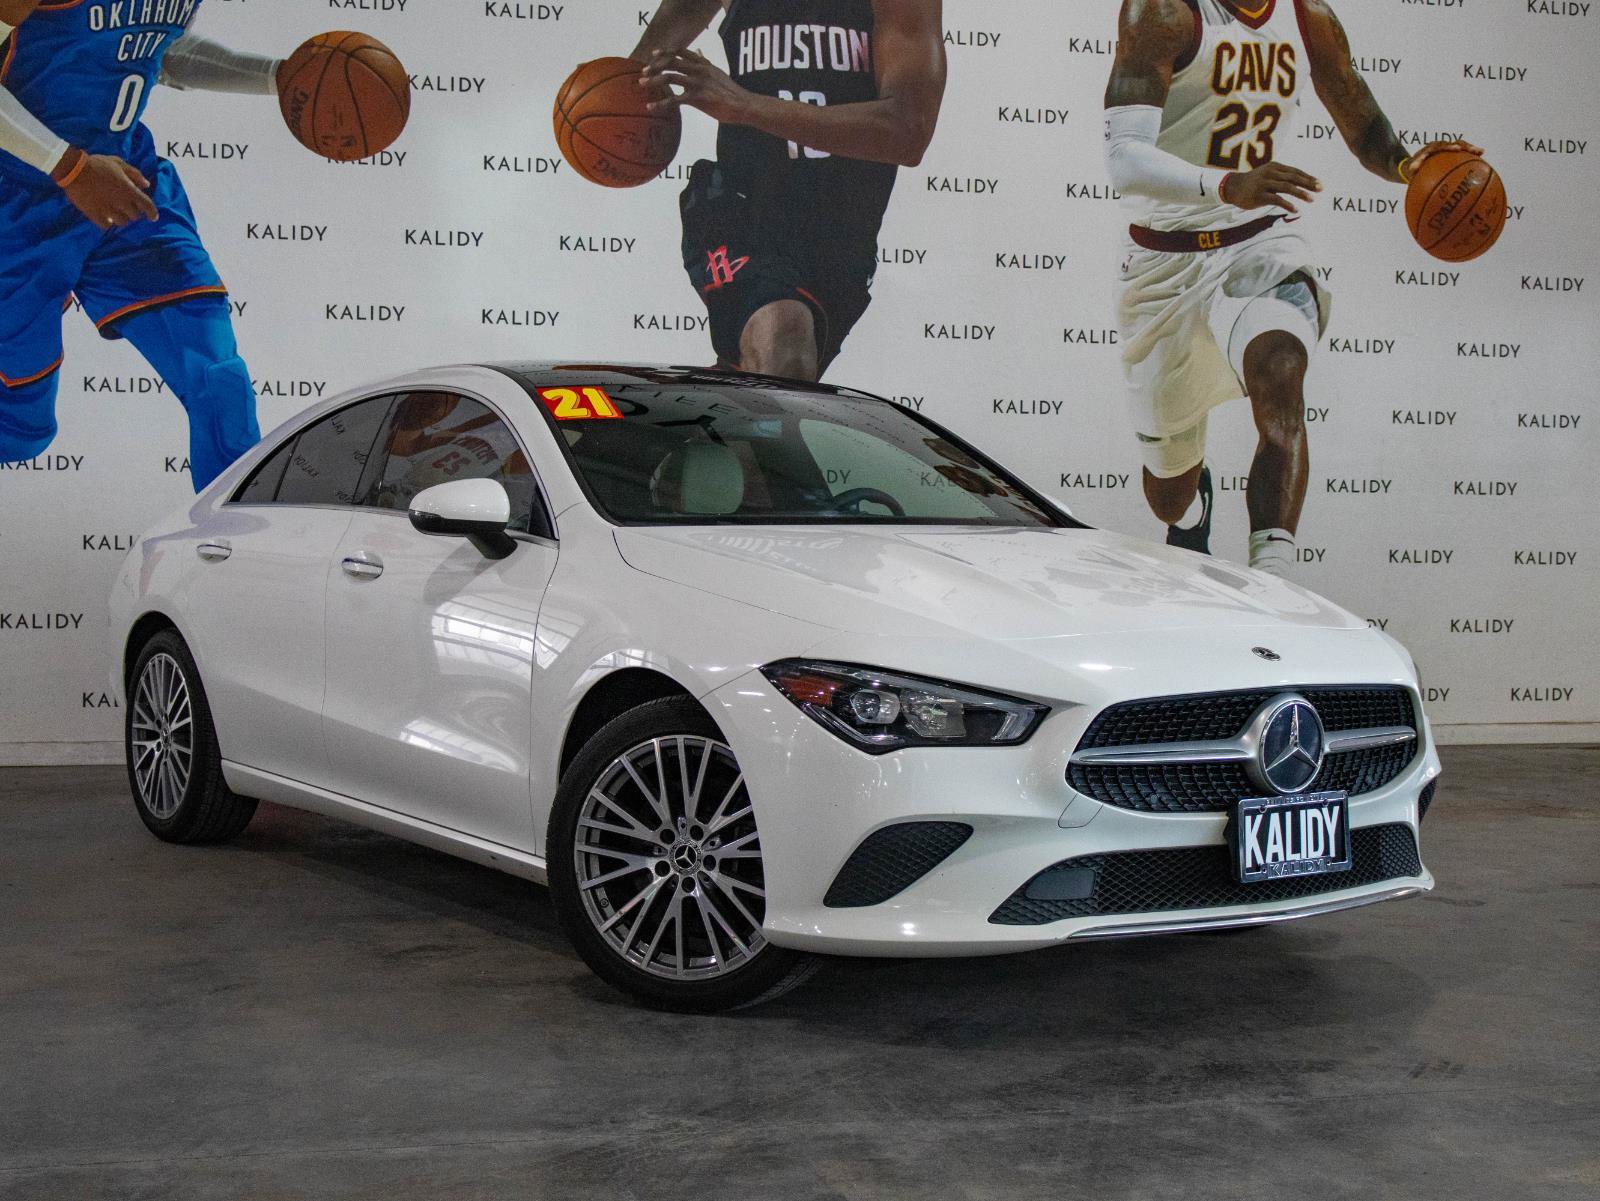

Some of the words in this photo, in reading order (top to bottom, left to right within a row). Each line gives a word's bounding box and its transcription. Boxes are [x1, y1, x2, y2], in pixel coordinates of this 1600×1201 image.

[89, 0, 196, 31] OKLAHOM
[486, 1, 564, 21] KALIDY
[1528, 0, 1591, 16] KALIDY
[117, 32, 167, 61] CITY
[944, 30, 1000, 47] ALIDY
[1069, 38, 1119, 54] KALI
[738, 24, 870, 75] HOUSTON
[1211, 40, 1297, 98] CAVS
[1351, 57, 1401, 73] ALIDY
[1464, 64, 1527, 81] KALIDY
[407, 74, 485, 93] KALIDY
[109, 74, 145, 132] 0
[999, 107, 1069, 124] KALIDY
[1206, 99, 1282, 172] 23
[168, 141, 248, 159] KALIDY
[1525, 138, 1587, 154] KALIDY
[484, 154, 562, 174] KALIDY
[928, 176, 998, 194] KALIDY
[1333, 197, 1399, 213] KALIDY
[247, 224, 328, 241] KALIDY
[406, 229, 484, 247] KALIDY
[1198, 231, 1221, 249] CLE
[560, 235, 636, 253] KALIDY
[876, 248, 927, 265] LIDY
[996, 253, 1066, 270] KALIDY
[1396, 270, 1460, 286] KALIDY
[1521, 276, 1584, 292] KALIDY
[326, 304, 405, 321] KALIDY
[482, 309, 560, 326] KALIDY
[634, 314, 709, 331] KALIDY
[925, 324, 995, 340] KALIDY
[1064, 329, 1118, 344] KALID
[1330, 338, 1395, 354] KALIDY
[1457, 343, 1520, 358] KALIDY
[84, 376, 165, 393] KALIDY
[542, 388, 618, 418] 21
[993, 399, 1063, 415] KALIDY
[1393, 410, 1456, 425] KALIDY
[1518, 414, 1580, 428] KALIDY
[1061, 473, 1129, 488] KALIDY
[1327, 479, 1392, 493] KALIDY
[1454, 481, 1517, 496] KALIDY
[83, 535, 132, 550] KALI
[1296, 548, 1325, 562] IDY
[1389, 549, 1453, 563] KALIDY
[1515, 551, 1577, 565] KALIDY
[1, 613, 83, 629] KALIDY
[1451, 619, 1514, 633] KALIDY
[1511, 687, 1573, 701] KALIDY
[1245, 805, 1340, 868] KALIDY
[1268, 858, 1324, 877] KALIDY
